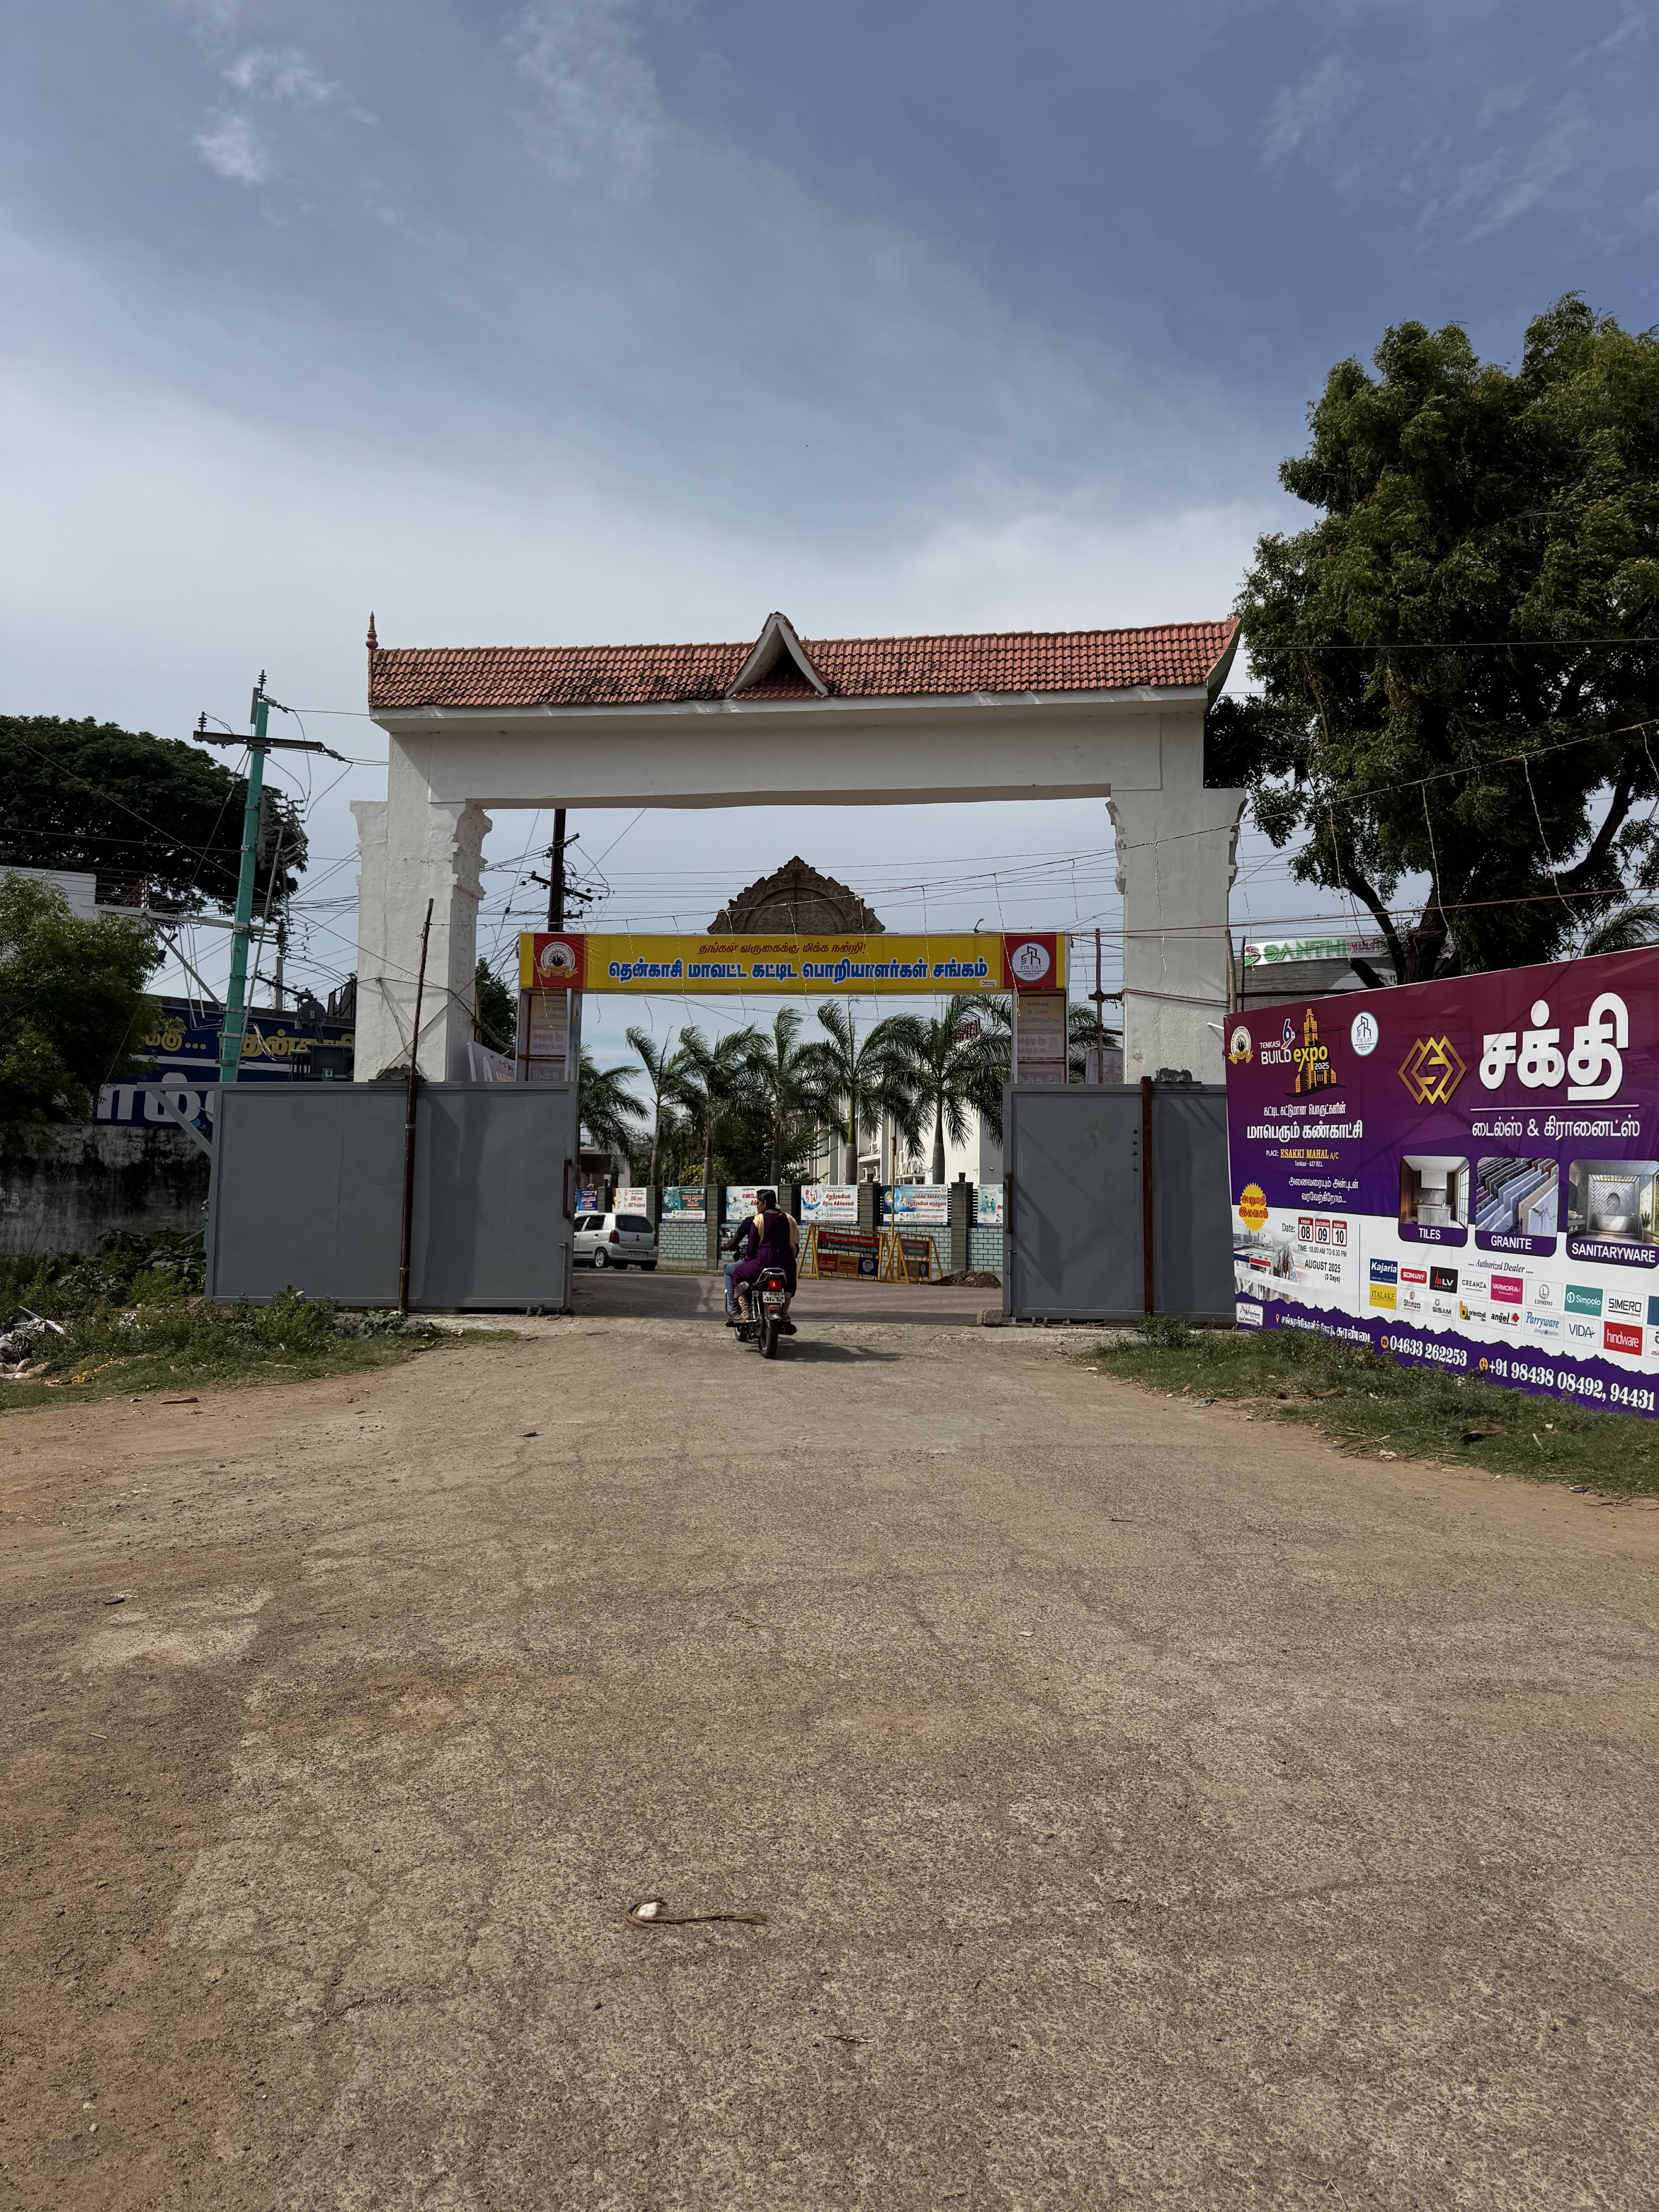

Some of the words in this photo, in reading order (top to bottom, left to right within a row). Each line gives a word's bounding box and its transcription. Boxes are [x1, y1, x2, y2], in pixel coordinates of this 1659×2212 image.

[698, 942, 737, 955] தங்கள்
[741, 942, 797, 955] வருகைக்கு
[803, 942, 829, 953] மிக்க
[1264, 939, 1347, 961] SANTHI
[608, 957, 683, 982] தென்காசி
[688, 963, 747, 978] மாவட்ட
[752, 962, 797, 982] கட்டிட
[803, 958, 928, 983] பொறியாளர்கள்
[933, 957, 988, 978] சங்கம்
[1259, 1041, 1281, 1049] TENKASI
[1479, 992, 1629, 1101] சக்தி
[1261, 1049, 1291, 1065] BUILD
[1294, 1046, 1328, 1072] expo
[1280, 1104, 1307, 1118] கட்டுமான
[1308, 1101, 1346, 1117] பொருட்களின்
[1247, 1120, 1300, 1143] மாபெரும்
[1302, 1119, 1363, 1139] கண்காட்சி
[1471, 1115, 1523, 1137] டைல்ஸ்
[1527, 1118, 1540, 1137] &
[1544, 1114, 1640, 1141] கிரானைட்ஸ்
[1280, 1149, 1305, 1159] ESAKKI
[1306, 1149, 1329, 1159] MAHAL
[1330, 1152, 1339, 1160] A/C
[1288, 1177, 1331, 1189] அனைவரையும்
[1332, 1178, 1359, 1191] அன்புடன்
[1241, 1194, 1266, 1206] அனுமதி
[1239, 1206, 1268, 1219] இலவசம்
[1282, 1223, 1295, 1233] Date:
[1301, 1226, 1310, 1239] 08
[1318, 1228, 1327, 1241] 09
[1418, 1228, 1441, 1240] TILES
[1335, 1230, 1344, 1243] 10
[1491, 1235, 1532, 1250] GRANITE
[1571, 1242, 1656, 1263] SANITARYWARE
[1305, 1259, 1327, 1271] AUGUST
[1329, 1263, 1341, 1273] 2025
[1371, 1262, 1397, 1273] Kajaria
[1475, 1259, 1503, 1271] Authorized
[1504, 1262, 1525, 1273] Dealer
[1403, 1271, 1424, 1280] SOMANY
[1462, 1279, 1487, 1288] CREANZA
[1492, 1283, 1518, 1292] VARMORA
[1371, 1290, 1395, 1300] ITALAKE
[1576, 1294, 1601, 1306] Simpolo
[1404, 1299, 1421, 1309] Stonza
[1432, 1306, 1451, 1315] SISAM
[1608, 1298, 1641, 1312] SIMERO
[1491, 1312, 1510, 1323] angel
[1526, 1311, 1559, 1328] Parryware
[1569, 1323, 1593, 1338] VIDA
[1607, 1329, 1639, 1347] hindware
[1389, 1335, 1423, 1357] 04633
[1424, 1343, 1467, 1366] 262253
[1489, 1358, 1508, 1378] +91
[1510, 1361, 1554, 1387] 98438
[1557, 1371, 1607, 1401] 08492,
[1610, 1383, 1655, 1412] 94431
